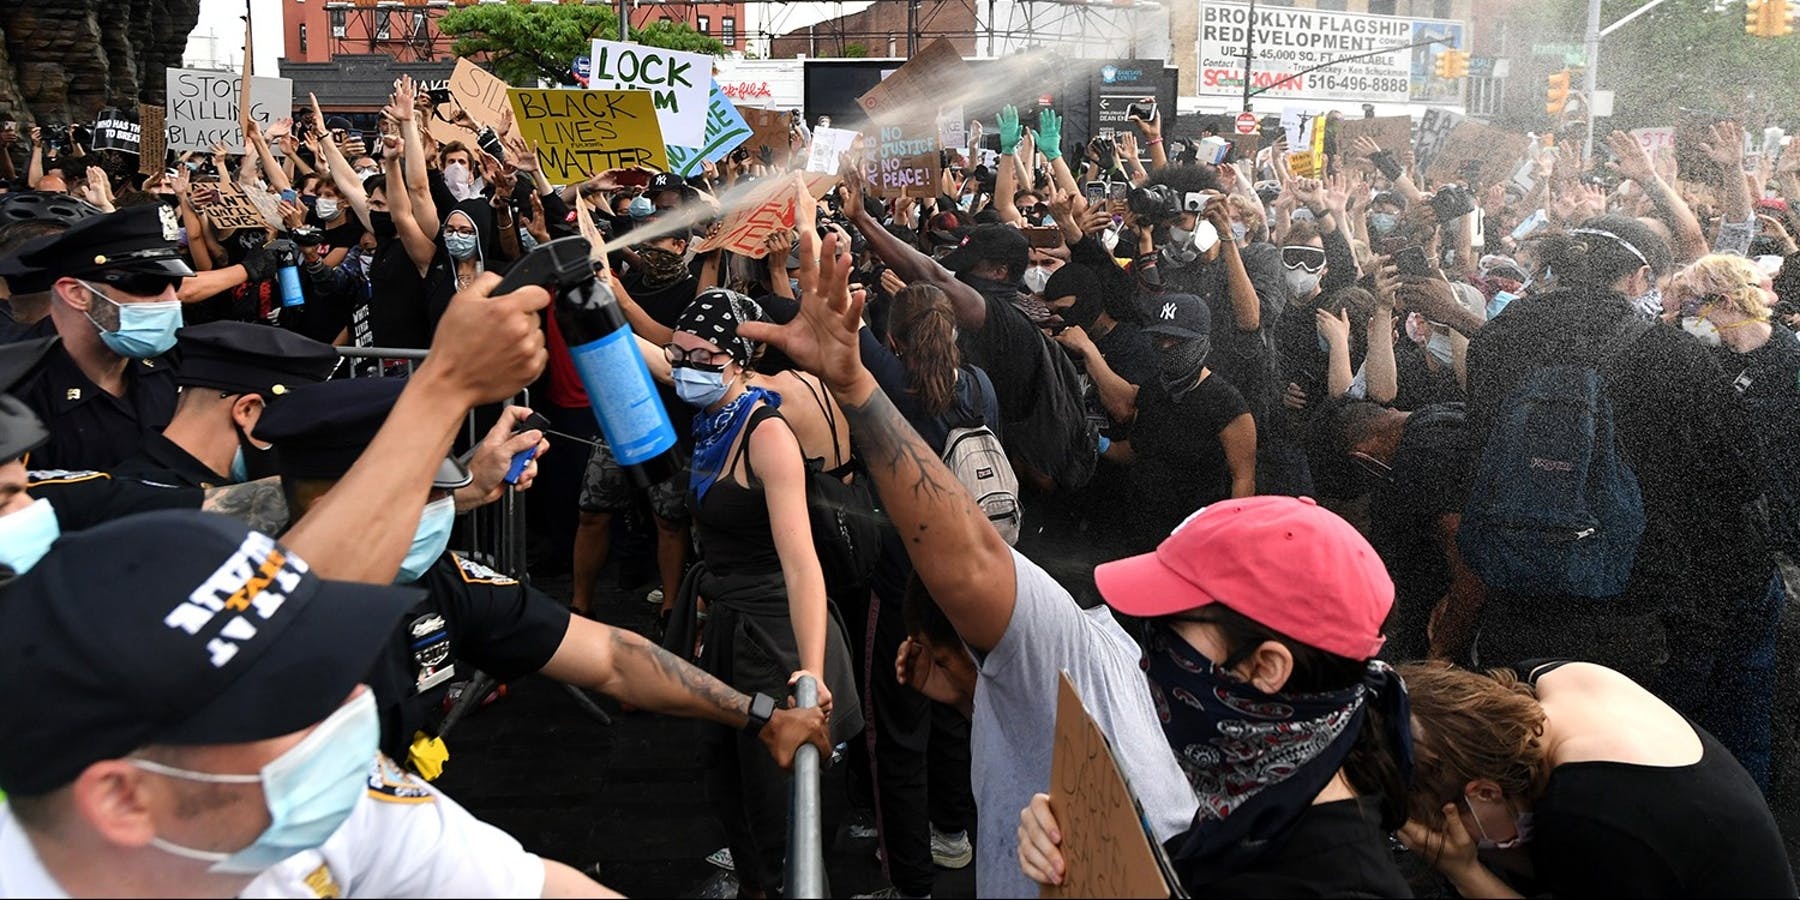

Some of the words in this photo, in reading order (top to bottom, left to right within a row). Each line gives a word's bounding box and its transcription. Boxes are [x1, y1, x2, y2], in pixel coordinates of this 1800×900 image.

[1204, 7, 1312, 29] BROOKLYN
[1319, 16, 1410, 36] FLAGSHIP
[1203, 25, 1376, 51] REDEVELOPMENT
[1203, 58, 1234, 68] Contact
[1221, 46, 1237, 57] UP
[1260, 48, 1296, 61] 45,000
[1338, 54, 1395, 66] AVAILABLE
[598, 46, 692, 88] LOCK
[178, 74, 243, 101] STOP
[1308, 74, 1408, 92] 516-496-8888
[518, 92, 637, 119] BLACK
[105, 129, 116, 138] TO
[112, 119, 129, 130] HAS
[540, 120, 618, 145] LIVES
[880, 126, 903, 142] NO
[880, 137, 935, 159] JUSTICE
[537, 147, 664, 179] MATTER
[881, 159, 900, 174] NO
[882, 168, 930, 189] PEACE!
[217, 216, 259, 227] LIVES
[1160, 302, 1177, 320] NY
